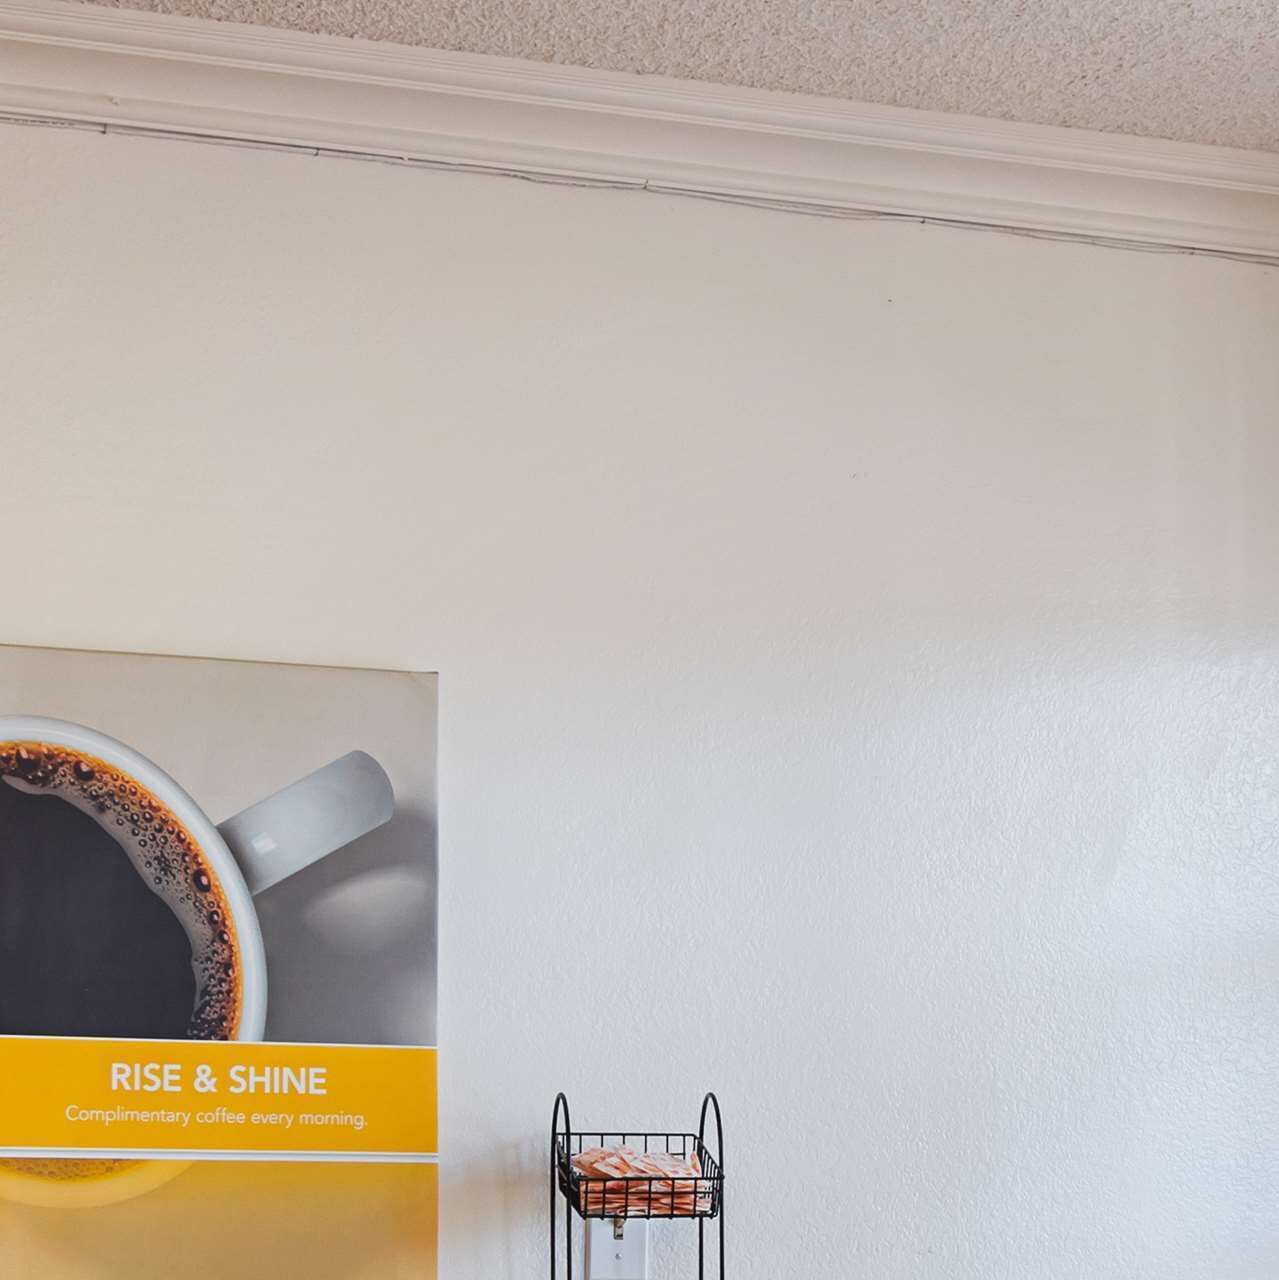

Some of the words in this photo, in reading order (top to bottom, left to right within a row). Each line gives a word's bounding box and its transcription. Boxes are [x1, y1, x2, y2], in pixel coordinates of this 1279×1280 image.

[111, 1063, 181, 1092] RISE
[194, 1065, 217, 1093] &
[229, 1066, 326, 1095] SHINE
[65, 1104, 191, 1127] Complimentary
[196, 1106, 246, 1125] coffee
[251, 1112, 294, 1128] every
[299, 1111, 368, 1129] morning.
